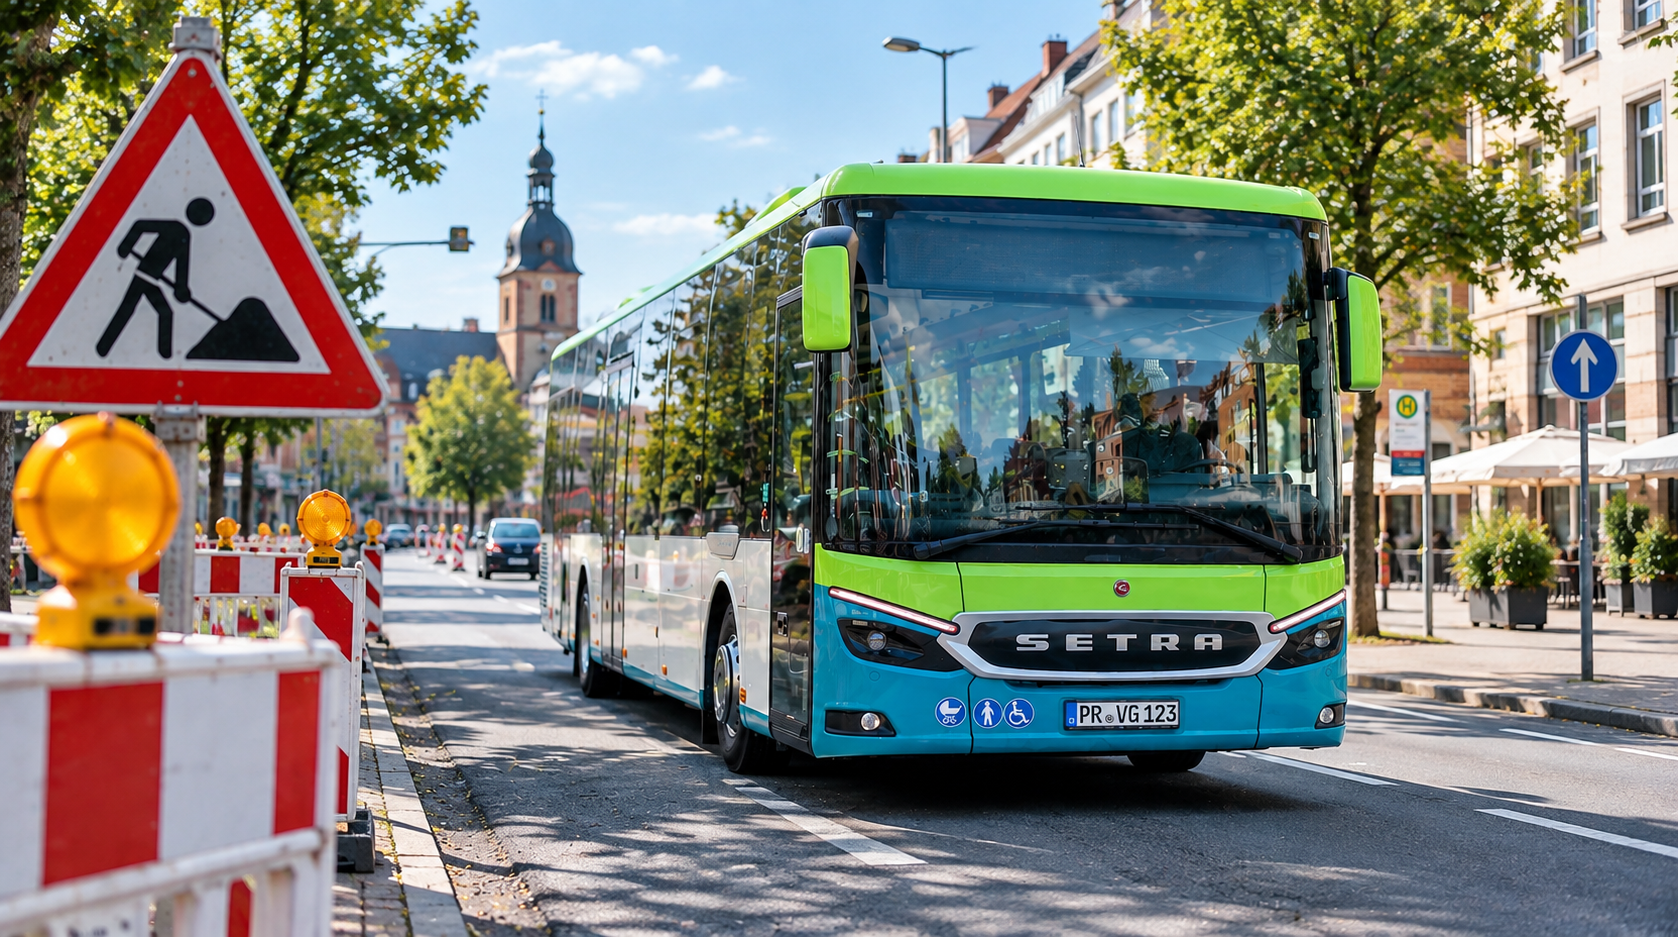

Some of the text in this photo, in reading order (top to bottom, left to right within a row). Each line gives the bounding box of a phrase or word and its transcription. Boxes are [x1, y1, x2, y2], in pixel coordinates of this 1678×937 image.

[1016, 634, 1223, 651] SETRA
[1080, 704, 1177, 723] PR VG 123
